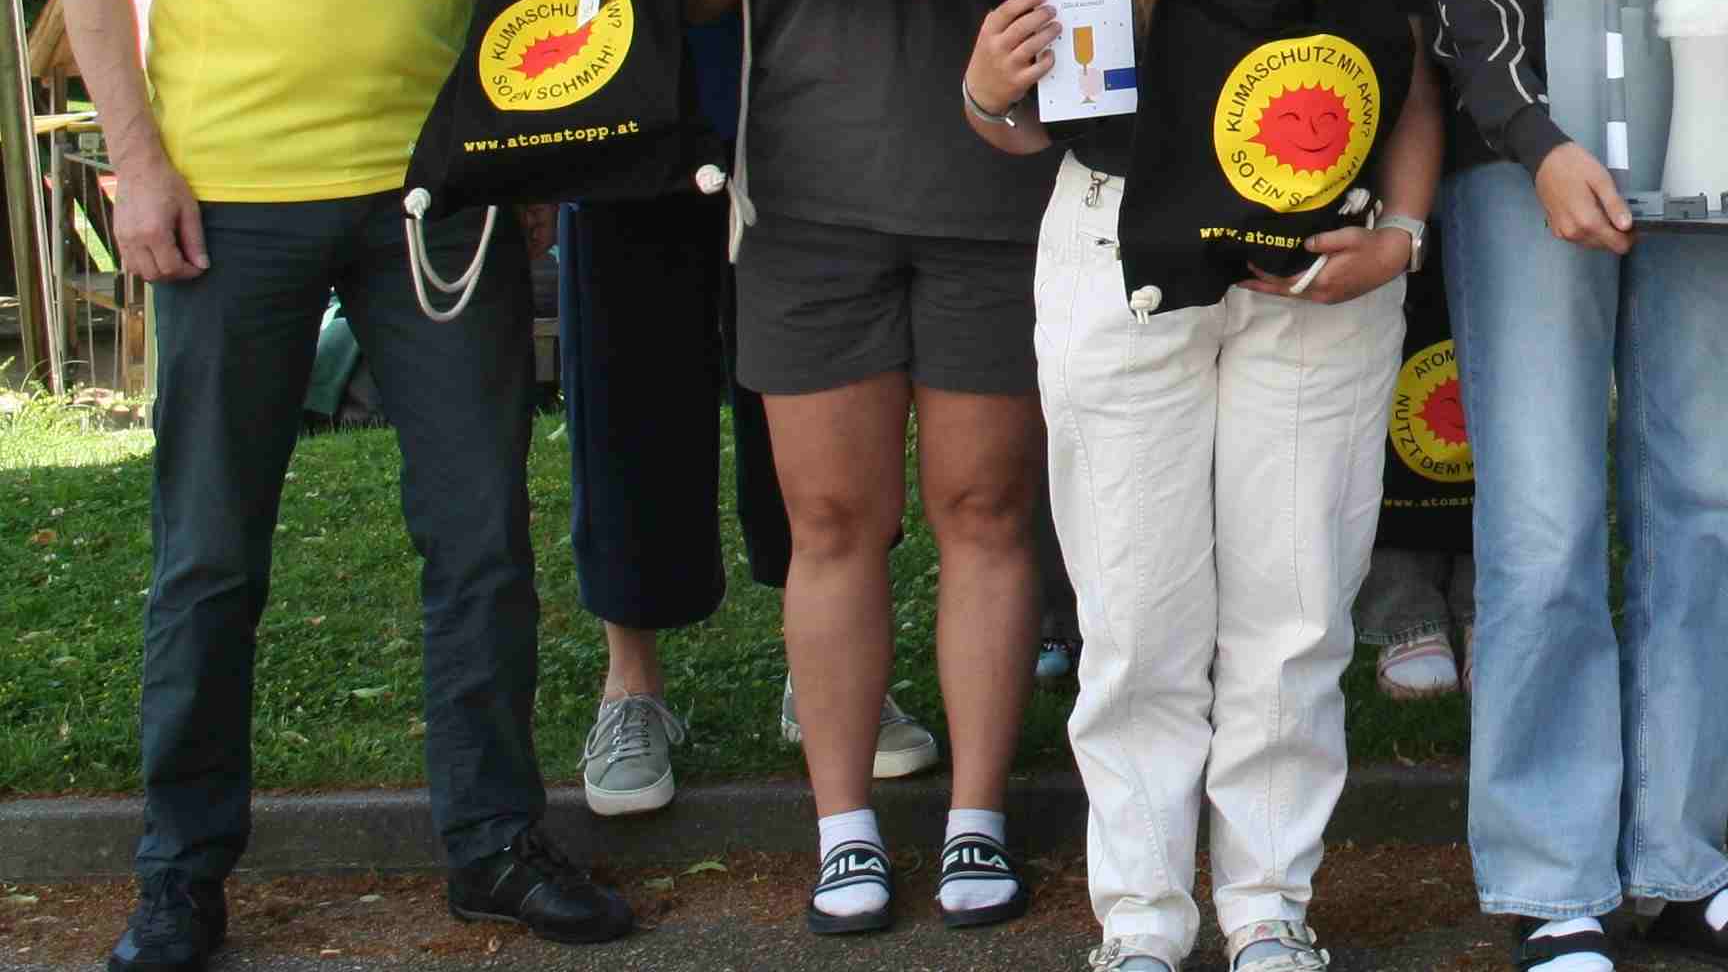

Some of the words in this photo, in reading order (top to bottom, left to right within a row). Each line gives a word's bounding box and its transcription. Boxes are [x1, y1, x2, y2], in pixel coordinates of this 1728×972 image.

[491, 4, 577, 60] KLIMASCHU
[492, 74, 513, 98] SO
[1226, 46, 1337, 133] KLIMASCHUTZ
[1336, 53, 1363, 81] MIT
[1358, 82, 1373, 138] AKW?
[463, 119, 640, 152] www.atomstopp.at
[1231, 149, 1255, 179] SO
[1251, 176, 1284, 200] EIN
[1200, 227, 1302, 249] www.atoms
[1394, 394, 1424, 458] NUTZT
[1419, 455, 1461, 476] DEM
[820, 853, 886, 885] FILA
[942, 847, 1010, 873] FILA
